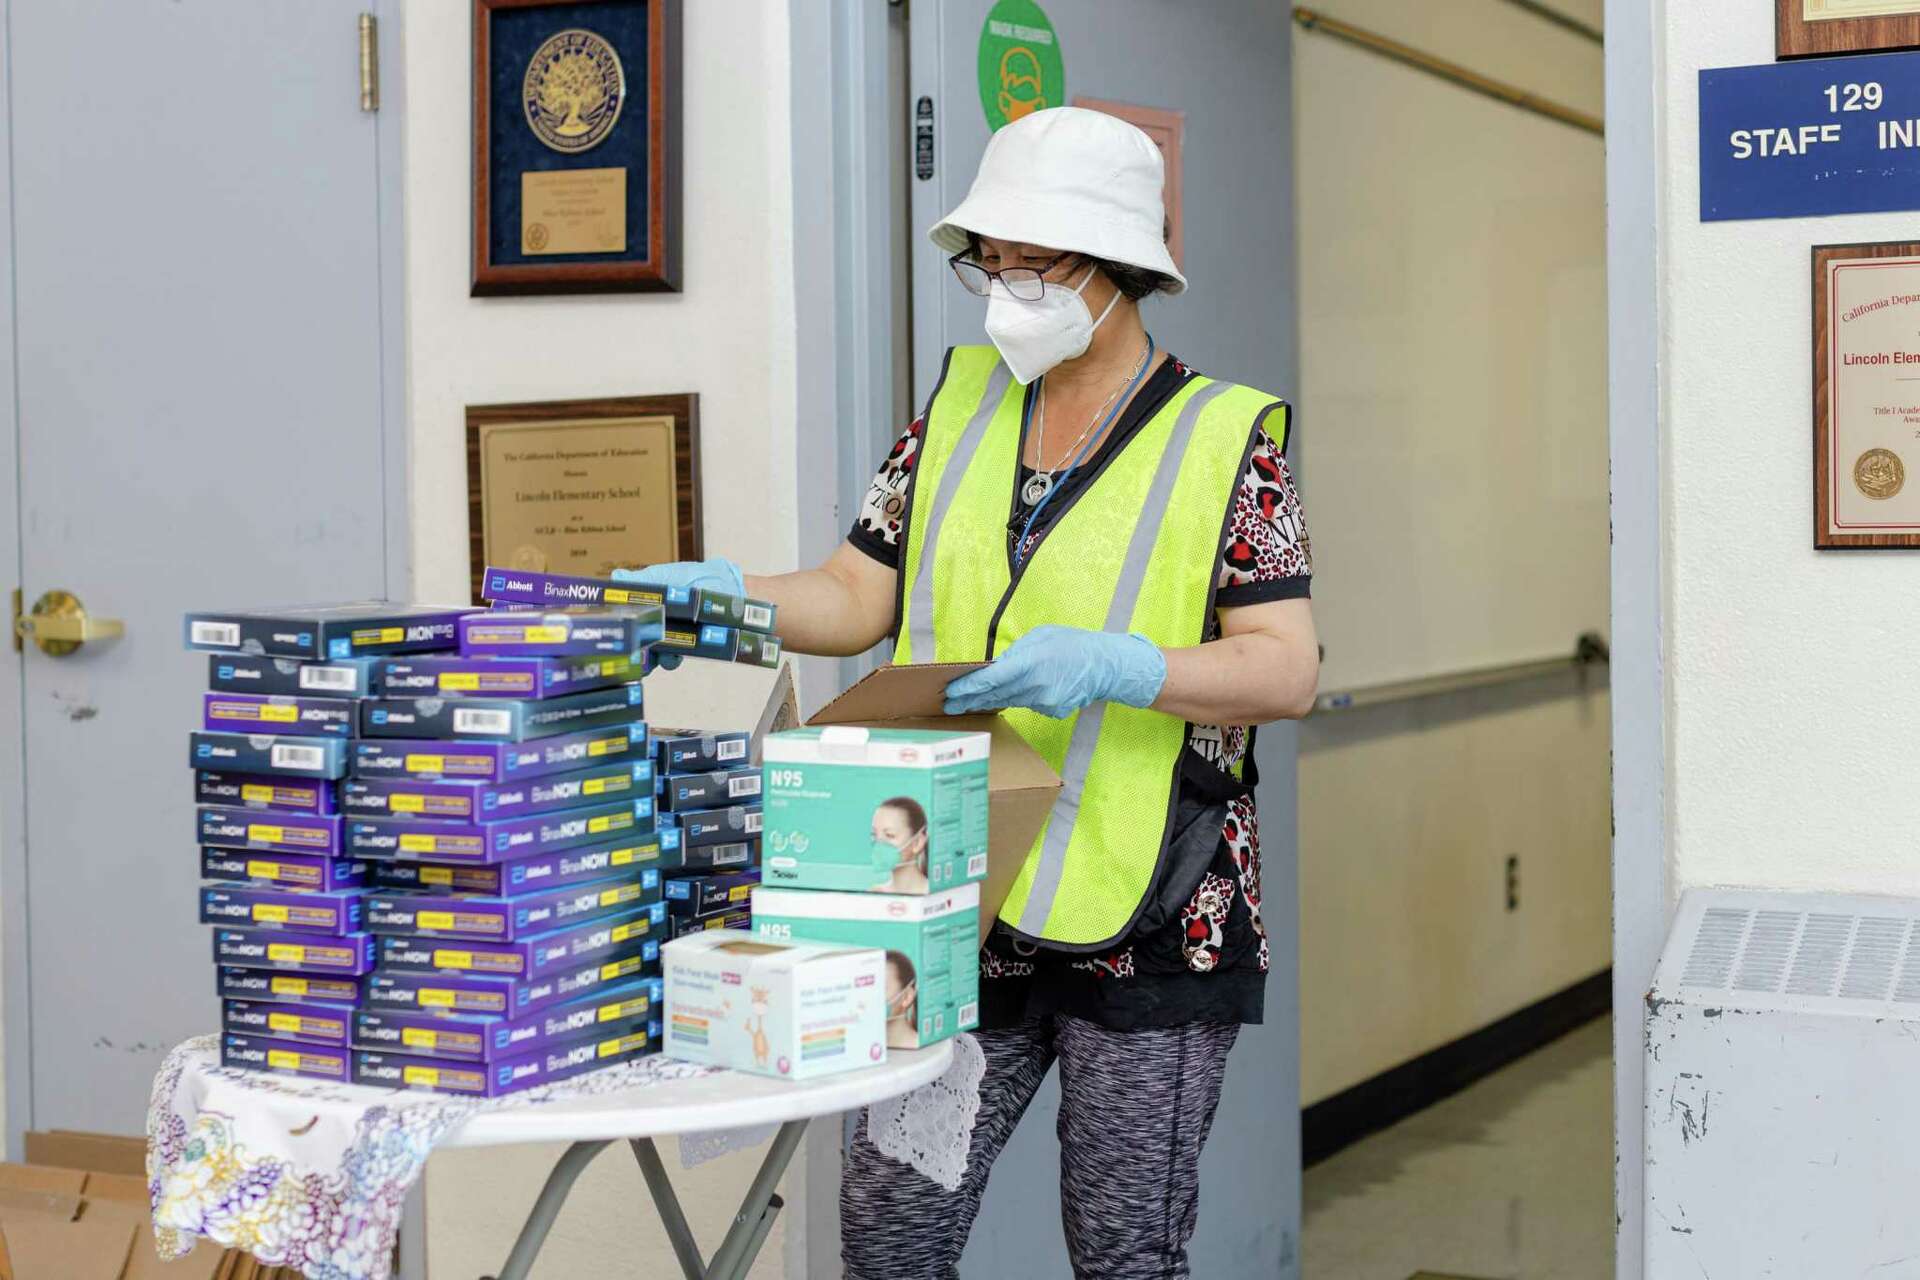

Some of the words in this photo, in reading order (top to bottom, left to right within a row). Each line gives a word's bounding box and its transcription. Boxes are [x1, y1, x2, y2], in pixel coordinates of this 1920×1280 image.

[1824, 82, 1883, 113] 129
[1879, 120, 1920, 150] IN
[1842, 300, 1889, 323] California
[1844, 353, 1889, 365] Lincoln
[1873, 407, 1890, 415] Title
[516, 491, 551, 502] Lincoln
[553, 489, 605, 502] Elementary
[609, 487, 640, 499] School
[506, 580, 533, 592] Abbott
[544, 582, 600, 600] BinaxNOW
[771, 770, 804, 787] N95
[760, 923, 791, 938] N95
